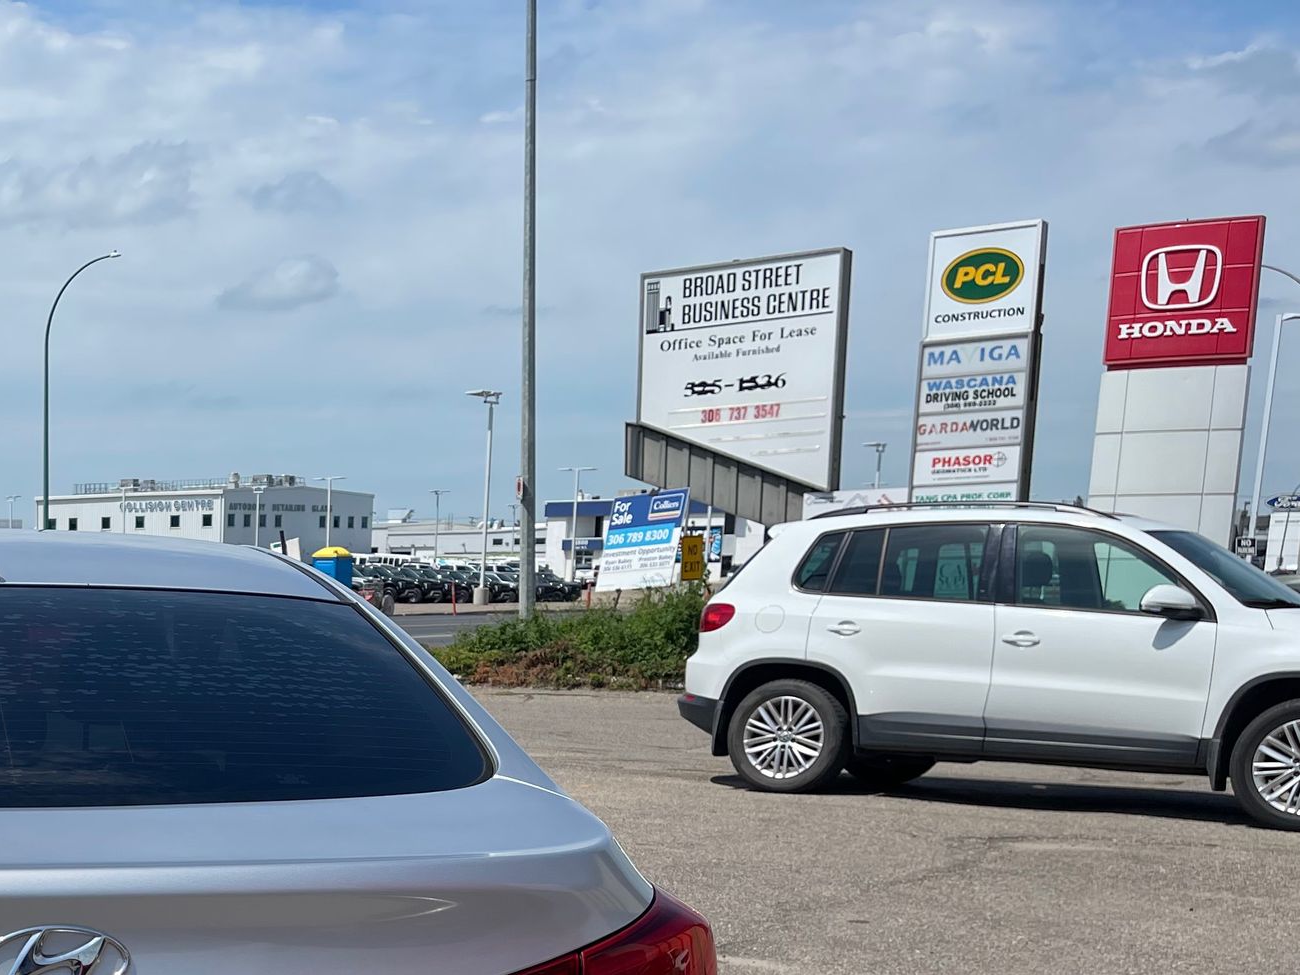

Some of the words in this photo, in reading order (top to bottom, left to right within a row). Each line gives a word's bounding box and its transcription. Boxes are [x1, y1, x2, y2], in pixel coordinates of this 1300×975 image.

[683, 273, 737, 298] BROAD
[743, 264, 803, 291] STREET
[954, 262, 1010, 289] PCL
[682, 295, 760, 324] BUSINESS
[766, 287, 830, 314] CENTRE
[934, 307, 1025, 324] CONSTRUCTION
[1117, 318, 1236, 339] HONDA
[660, 337, 703, 352] Office
[708, 332, 745, 348] Space
[752, 330, 774, 343] For
[780, 325, 817, 339] Lease
[692, 350, 733, 362] Available
[736, 344, 781, 358] Furnished
[927, 375, 1017, 391] WASCANA
[925, 390, 969, 403] DRIVING
[972, 387, 1017, 400] SCHOOL
[701, 409, 721, 424] 306
[728, 406, 749, 421] 737
[754, 403, 781, 420] 3547
[931, 454, 993, 468] PHASOR
[120, 500, 172, 513] COLLISION
[173, 499, 214, 512] CENTRE
[614, 501, 632, 513] For
[653, 500, 679, 510] Colliers
[611, 513, 633, 526] Sale
[607, 534, 625, 545] 306
[627, 531, 643, 543] 789
[645, 529, 669, 541] 8300
[1240, 539, 1252, 547] NO
[688, 544, 698, 556] NO
[684, 561, 700, 573] EXIT
